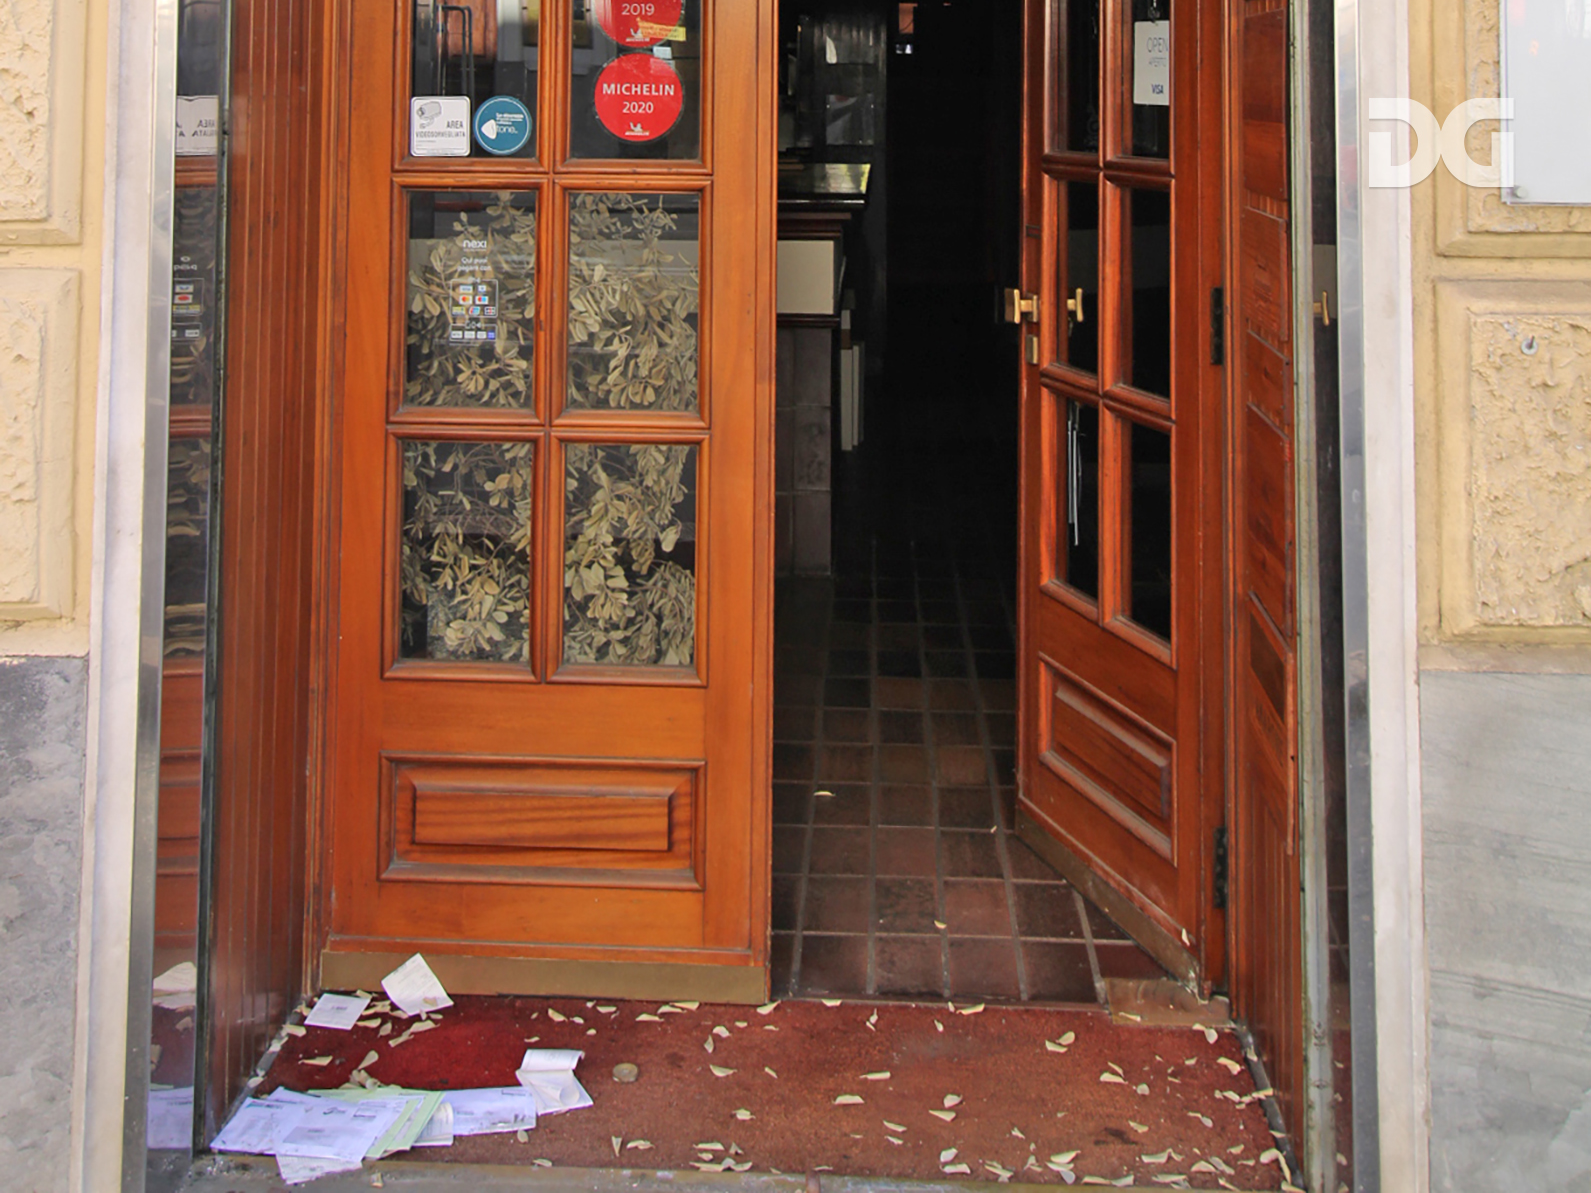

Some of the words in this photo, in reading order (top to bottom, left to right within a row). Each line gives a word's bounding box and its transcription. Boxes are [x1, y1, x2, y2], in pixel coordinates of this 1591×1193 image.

[621, 3, 655, 16] 2019
[602, 83, 675, 96] MICHELIN
[1151, 84, 1164, 94] VISA
[622, 102, 654, 114] 2020
[446, 120, 464, 129] AREA
[463, 239, 487, 248] nexi
